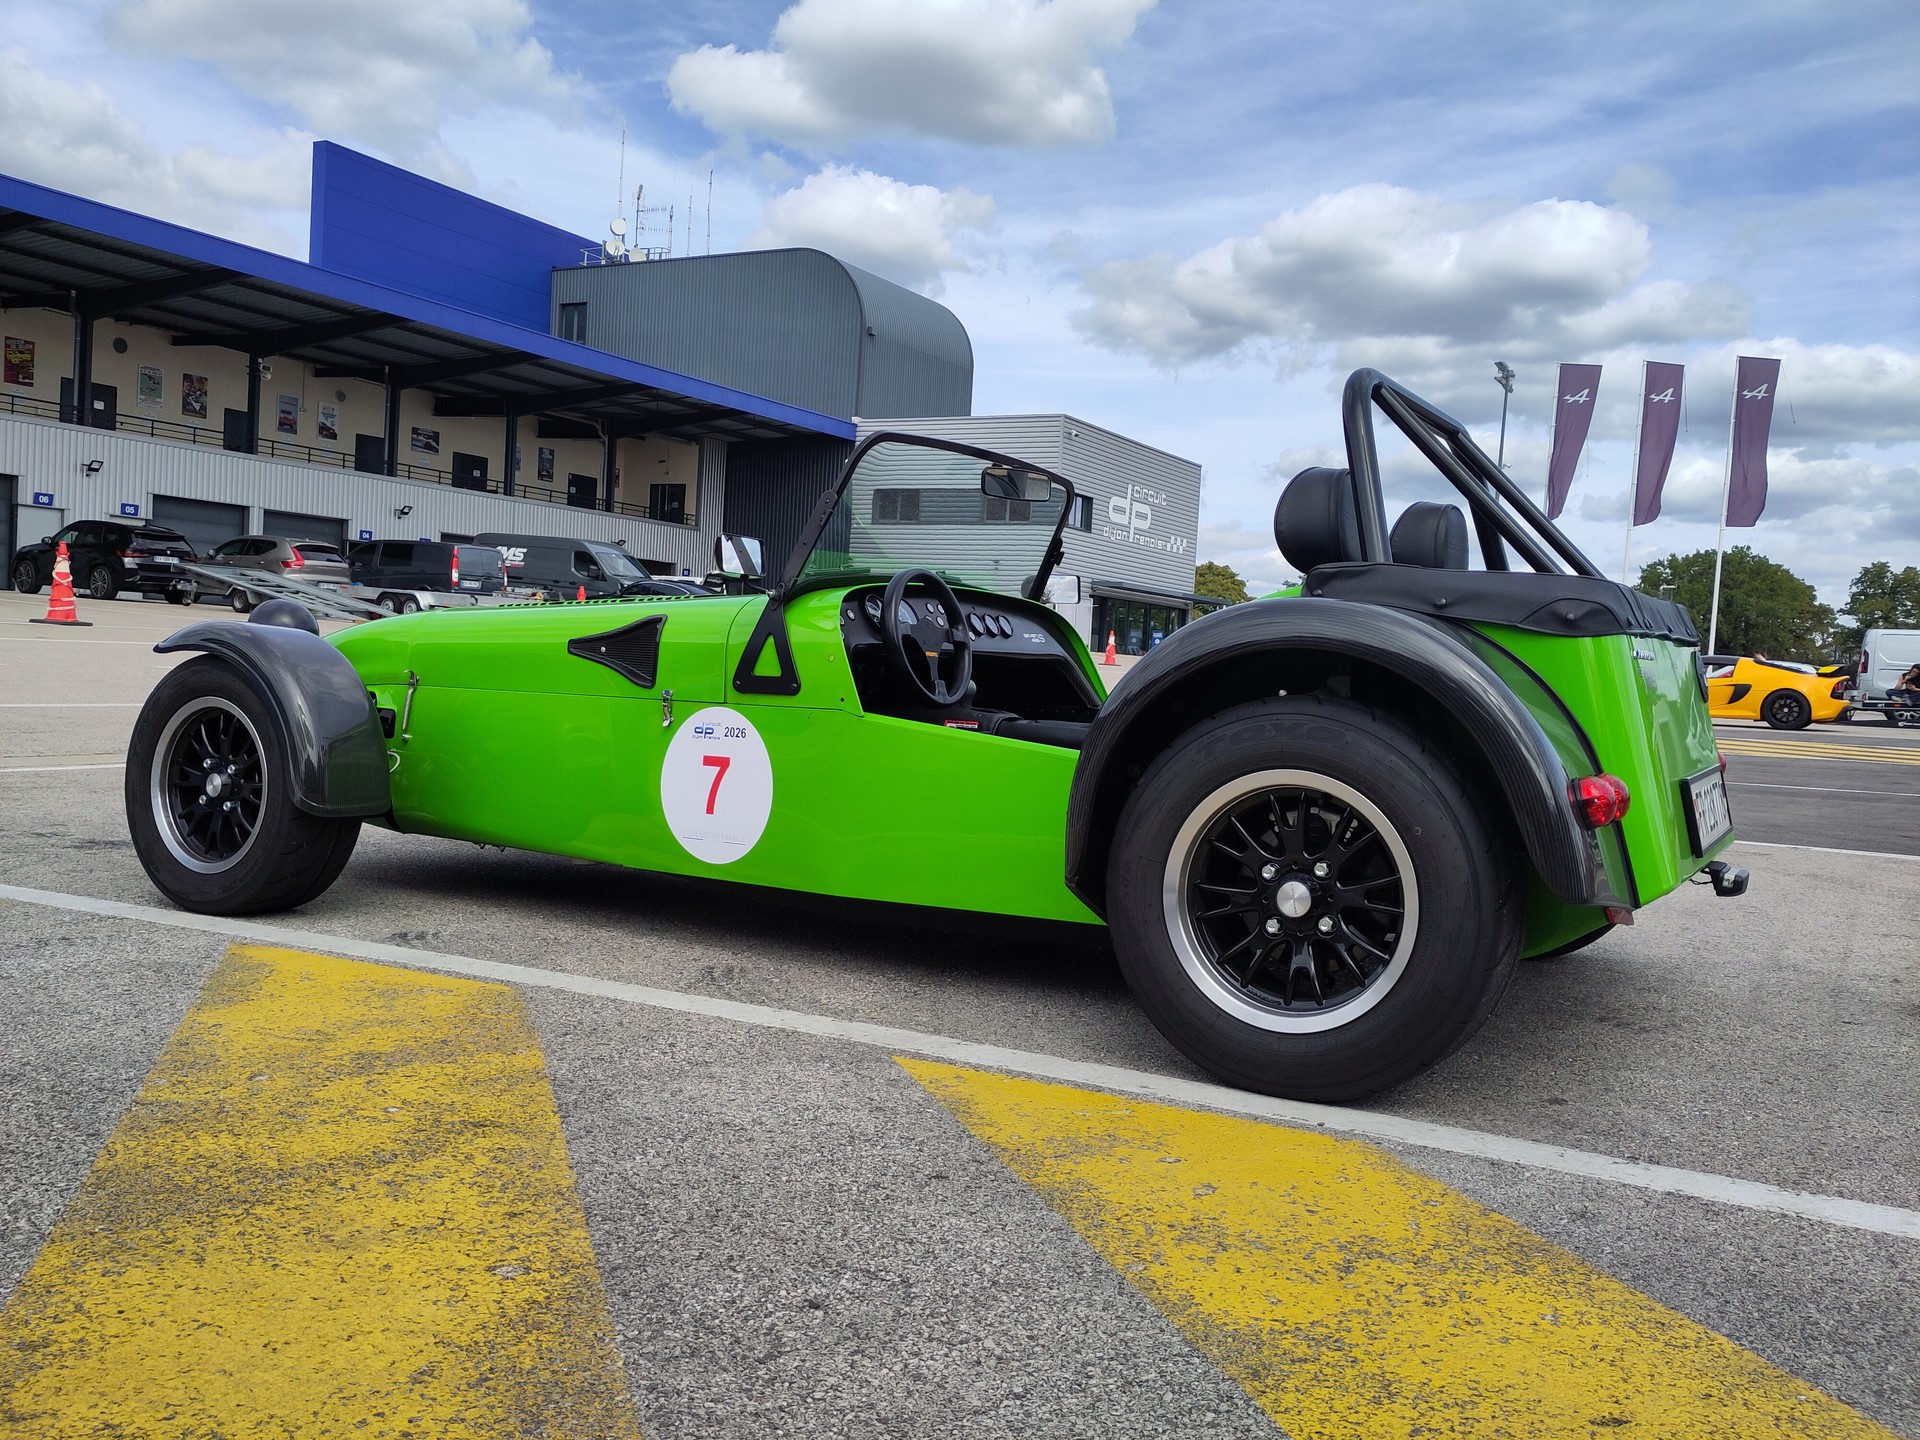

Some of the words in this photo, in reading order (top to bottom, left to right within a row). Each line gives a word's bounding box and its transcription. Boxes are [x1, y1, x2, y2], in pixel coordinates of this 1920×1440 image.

[38, 495, 49, 503] 06
[1133, 485, 1167, 505] circuit
[125, 505, 135, 513] 05
[724, 726, 747, 739] 2026
[702, 755, 731, 815] 7
